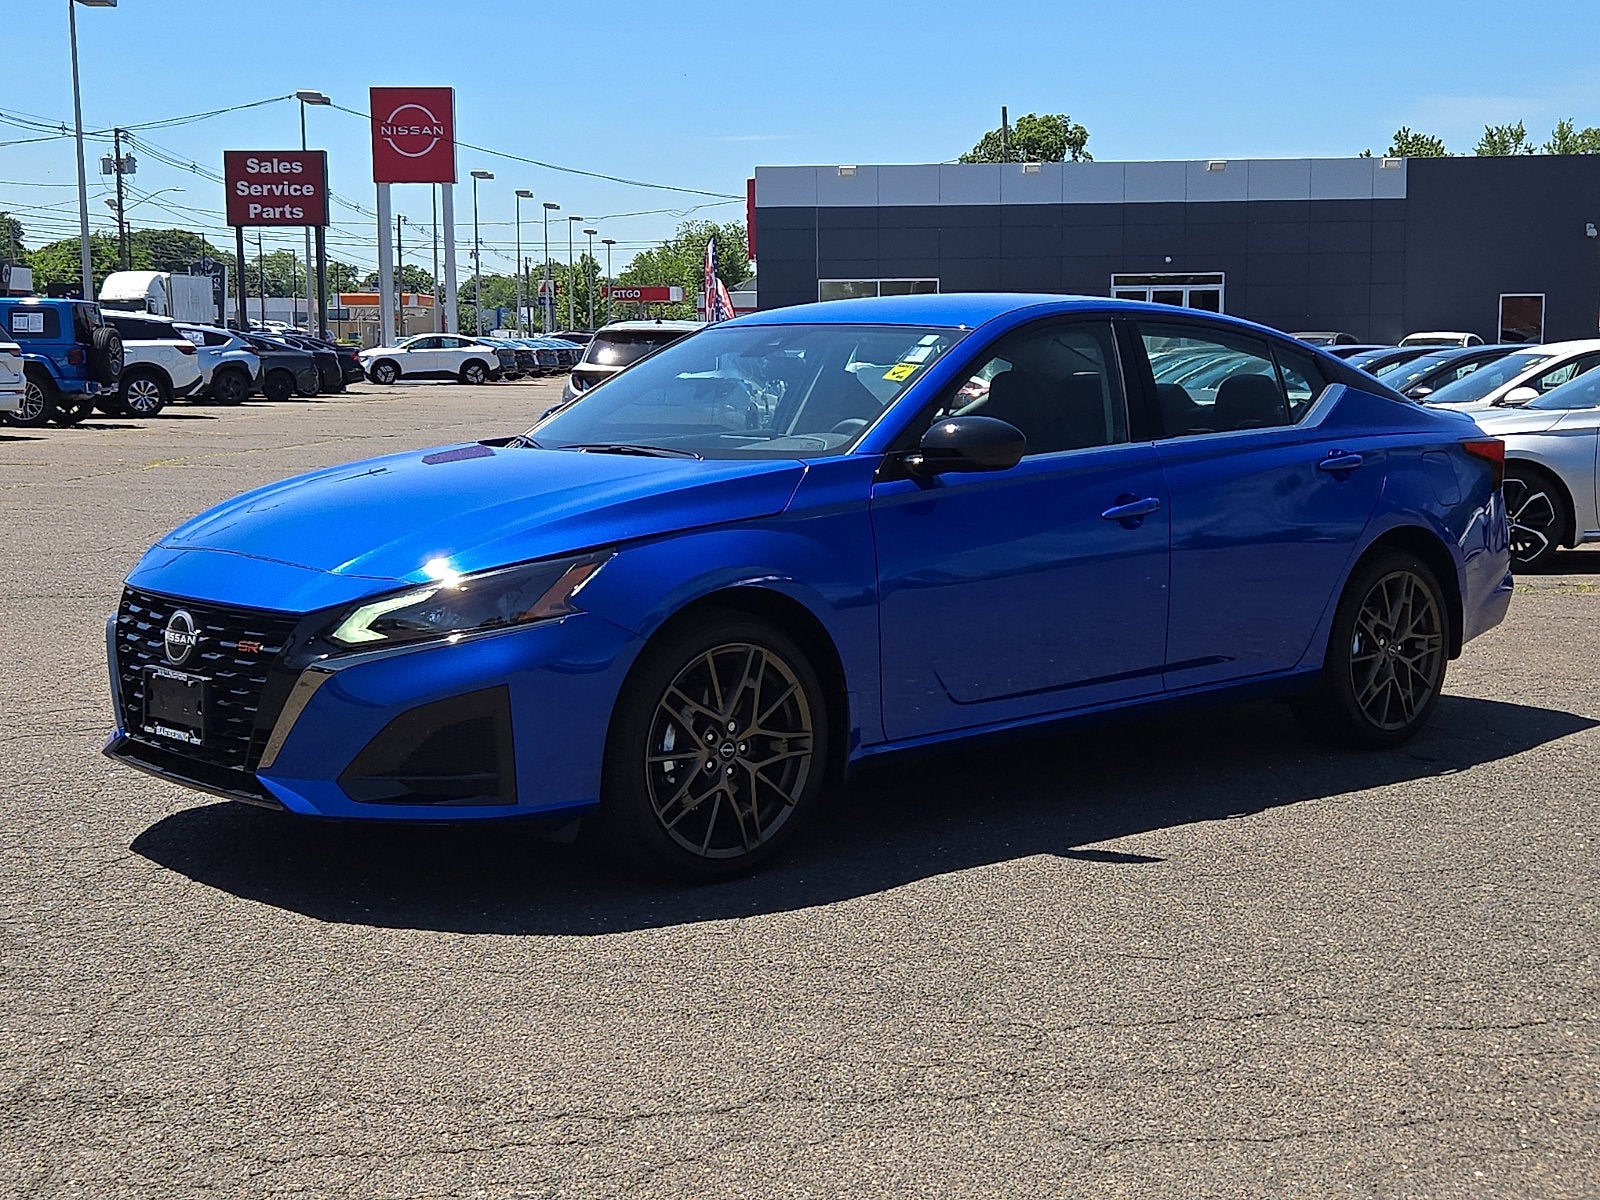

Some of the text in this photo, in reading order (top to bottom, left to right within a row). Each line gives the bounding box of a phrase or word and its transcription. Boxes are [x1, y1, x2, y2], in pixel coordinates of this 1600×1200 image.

[381, 126, 444, 135] NISSAN
[246, 158, 303, 173] Sales
[236, 181, 315, 196] Service
[249, 203, 304, 219] Parts
[612, 289, 641, 299] CITGO
[165, 631, 196, 646] SSAN
[238, 640, 260, 653] SR
